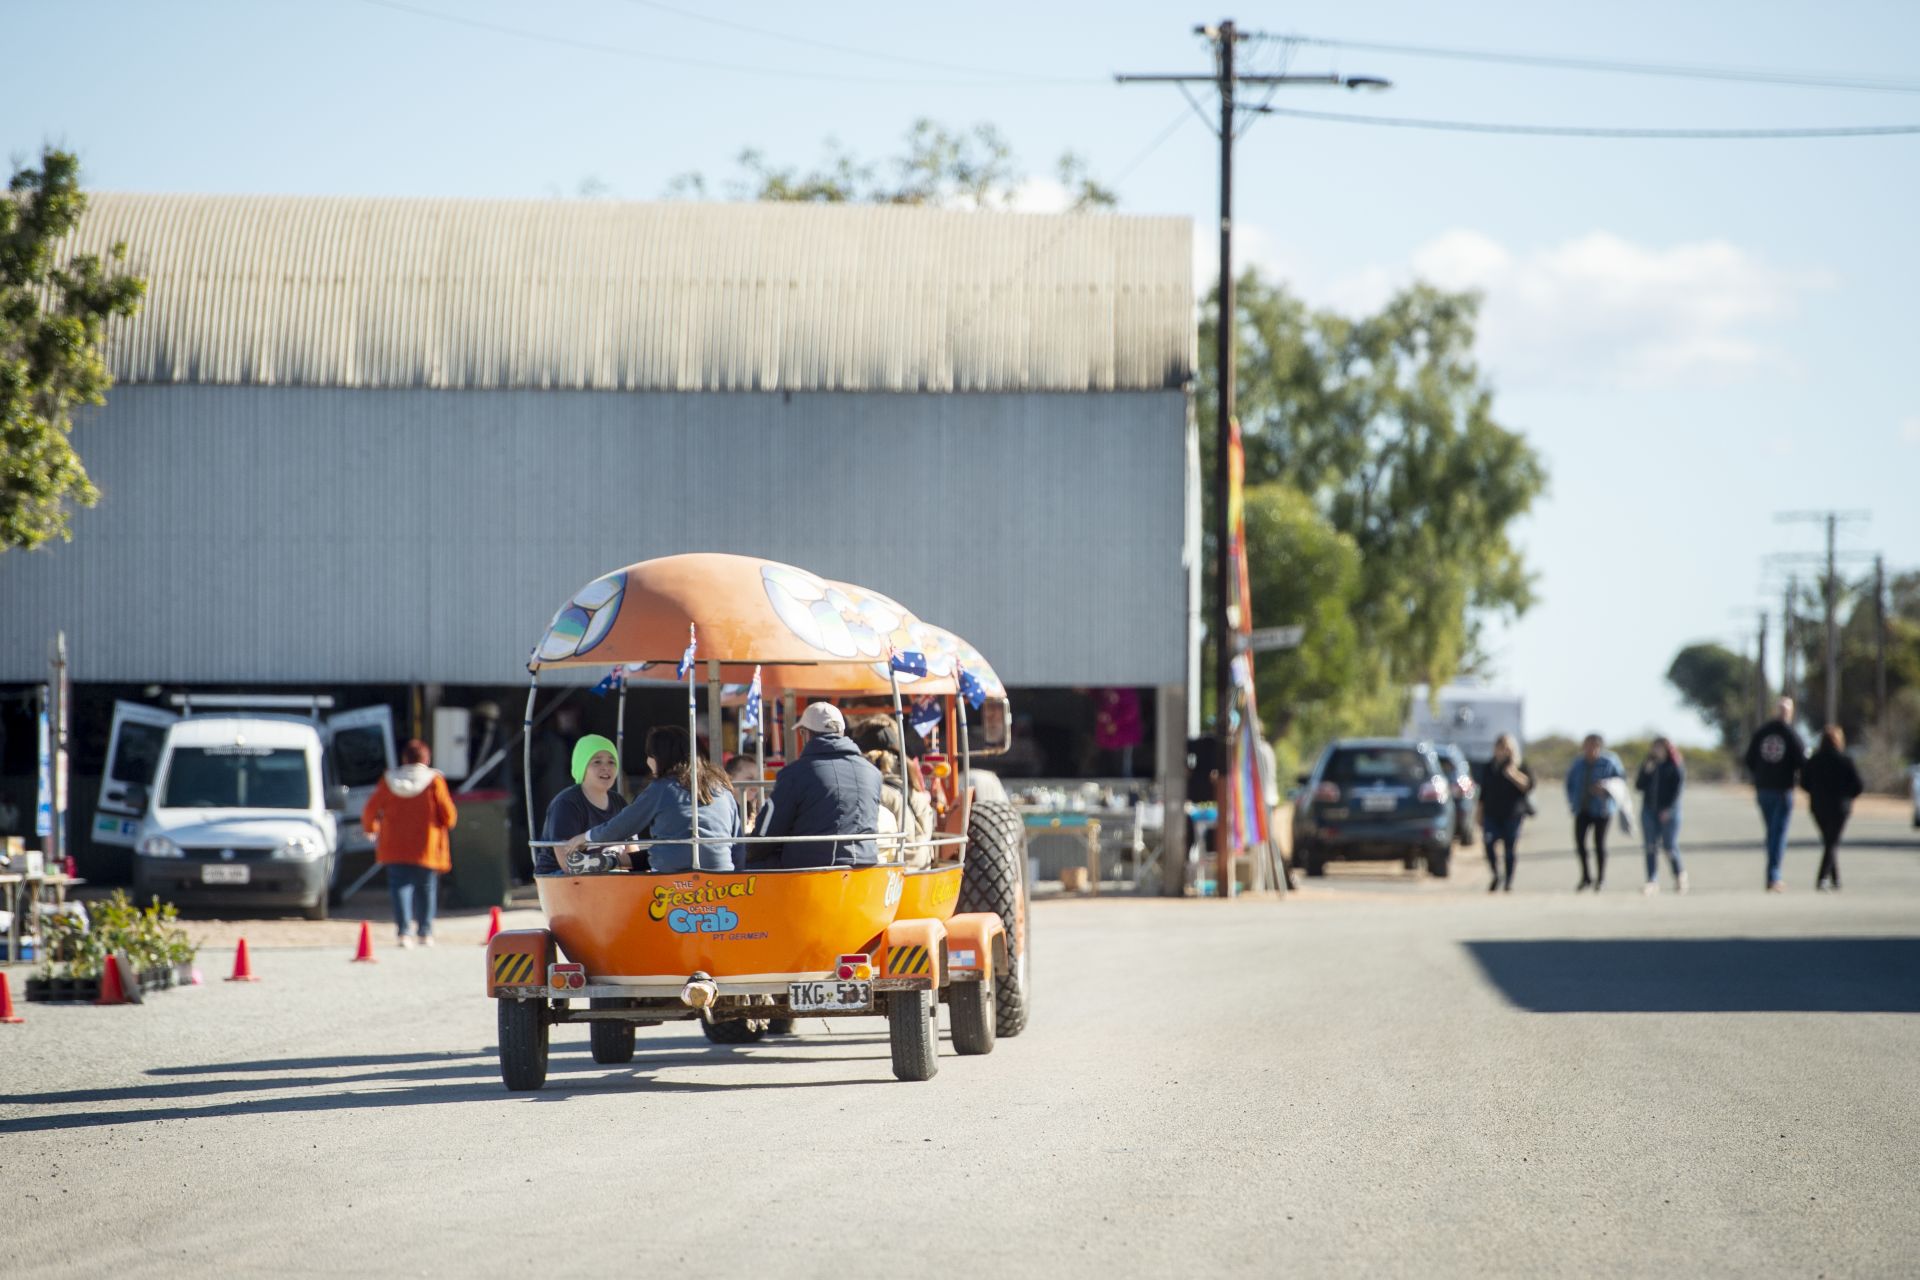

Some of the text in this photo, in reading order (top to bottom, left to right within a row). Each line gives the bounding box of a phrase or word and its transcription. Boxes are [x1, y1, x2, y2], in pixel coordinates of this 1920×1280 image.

[673, 881, 694, 889] THE
[649, 876, 757, 920] Festival
[668, 906, 738, 933] Crab
[712, 931, 768, 941] PT GERMEIN
[791, 982, 824, 1005] TKG
